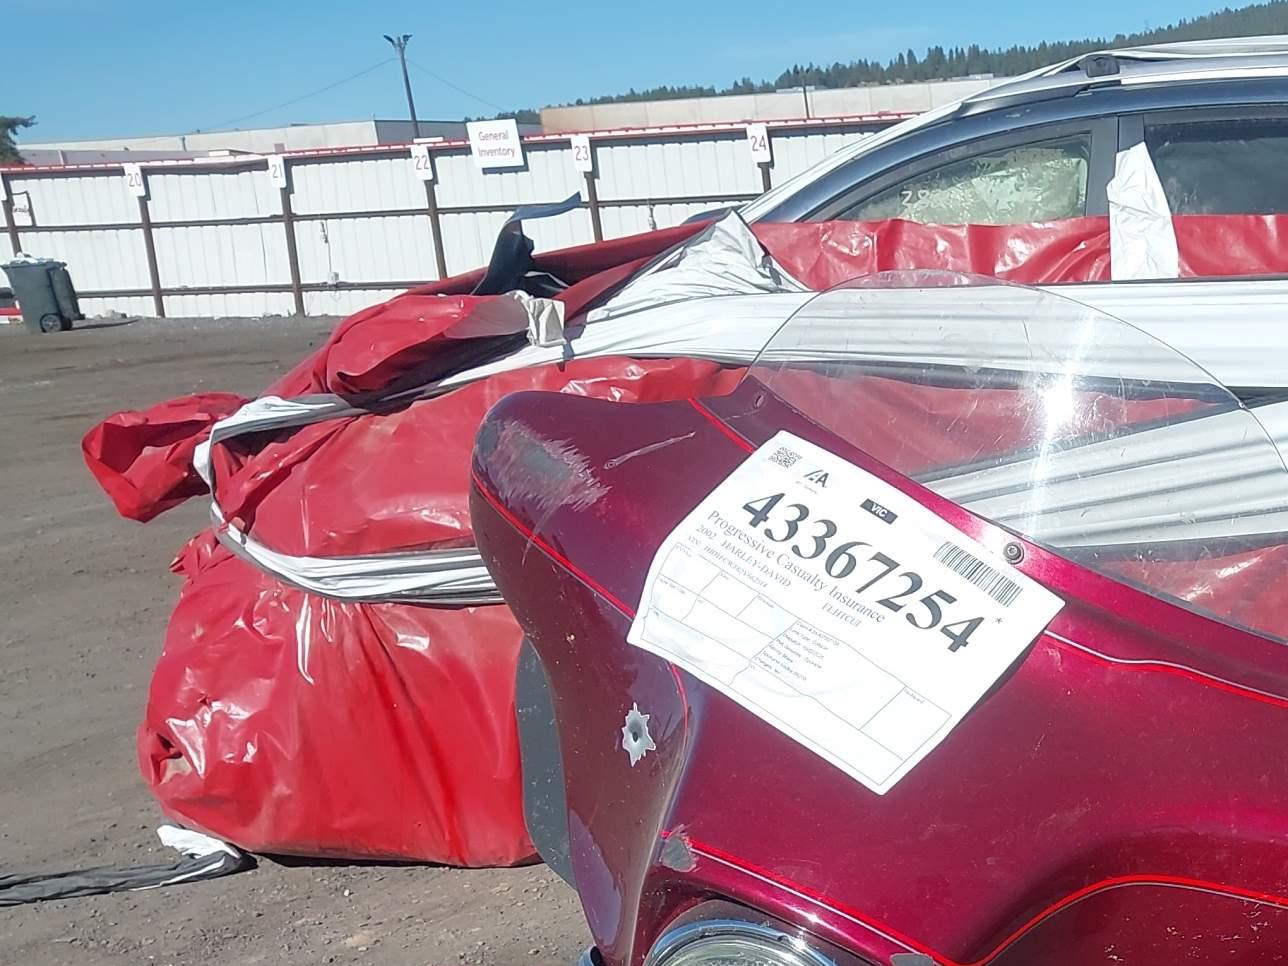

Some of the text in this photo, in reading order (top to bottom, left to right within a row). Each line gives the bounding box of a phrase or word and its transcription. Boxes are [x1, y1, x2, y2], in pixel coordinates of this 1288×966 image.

[478, 130, 509, 141] General
[750, 135, 767, 152] 24
[478, 146, 516, 158] Inventory
[574, 145, 589, 161] 23
[271, 163, 283, 179] 21
[415, 155, 430, 171] 22
[128, 172, 142, 188] 20
[696, 524, 718, 542] 2002
[720, 539, 792, 588] HARLEY-DAVID
[707, 510, 775, 559] Progressive
[776, 553, 828, 592] Casualty
[828, 585, 886, 623] Insurance
[742, 493, 985, 653] 43367254
